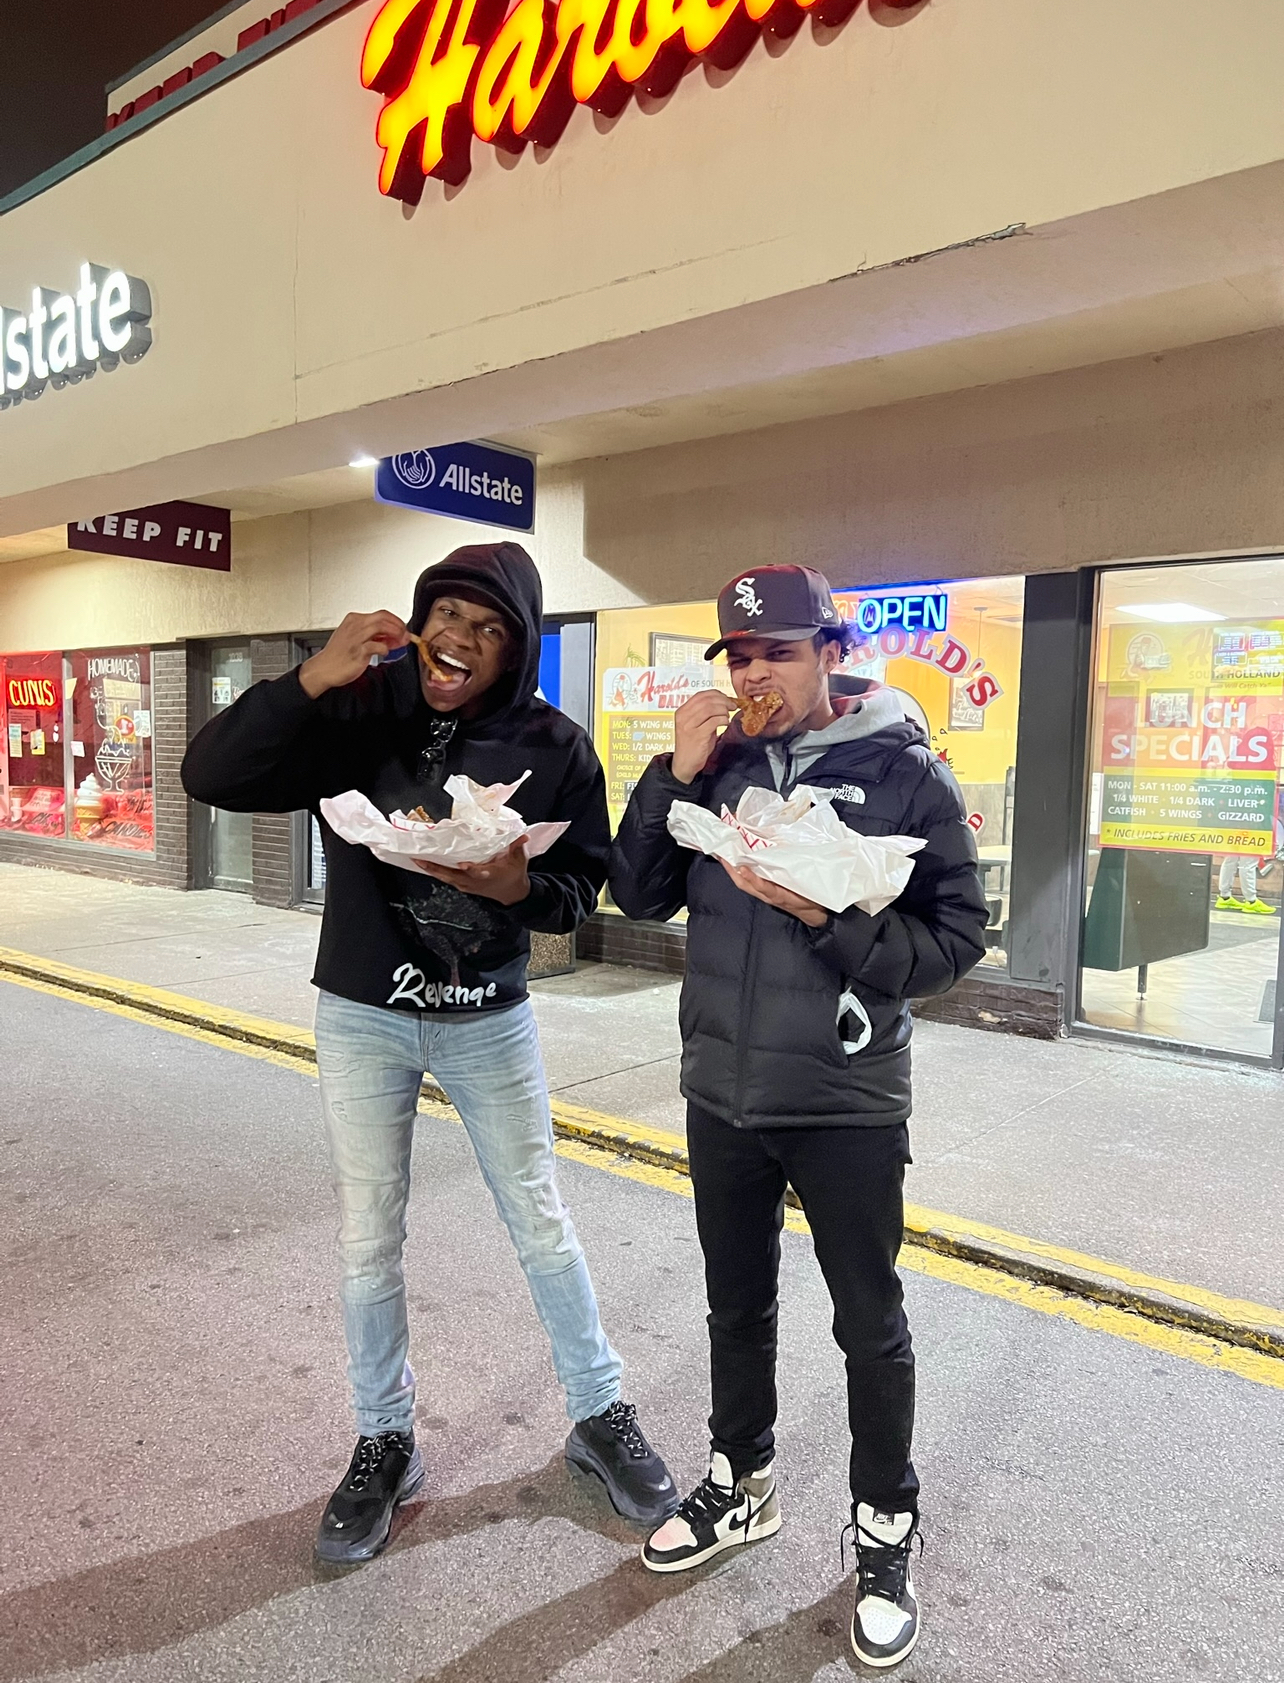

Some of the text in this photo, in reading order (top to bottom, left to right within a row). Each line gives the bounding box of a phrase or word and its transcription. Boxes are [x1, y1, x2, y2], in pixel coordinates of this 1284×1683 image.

[439, 464, 523, 505] Allstate
[77, 515, 222, 552] KEEP FIT
[857, 595, 946, 633] OPEN
[87, 657, 135, 682] HOMEMADE
[1227, 669, 1281, 679] HOLLAND
[637, 671, 690, 702] Harold's
[691, 680, 700, 688] OF
[701, 680, 724, 688] SOUTH
[1135, 702, 1247, 729] LUNCH
[612, 720, 631, 729] MON:
[640, 720, 660, 729] WING
[662, 720, 675, 729] ME
[612, 731, 671, 740] TUES: WINGS
[612, 742, 630, 750] WED:
[632, 743, 643, 751] 1/2
[1110, 734, 1268, 763] SPECIALS
[612, 753, 652, 762] THURS: KID
[611, 781, 625, 790] FRI:
[842, 783, 856, 792] THE
[1108, 780, 1131, 790] MON
[1139, 782, 1157, 790] SAT
[1160, 783, 1186, 792] 11:00
[1188, 784, 1211, 793] a.m.
[1219, 785, 1241, 794] 2:30
[1244, 786, 1268, 796] p.m.
[611, 792, 625, 801] SAT:
[834, 793, 853, 803] FACE
[1113, 793, 1127, 802] 1/4
[1129, 794, 1159, 803] WHITE
[1169, 796, 1183, 805] 1/4
[1186, 797, 1215, 806] DARK
[1108, 806, 1265, 822] CATFISH 5 WINGS GIZZARD
[1114, 828, 1266, 847] INCLUDES FRIES AND BREAD
[386, 962, 497, 1008] Revenge
